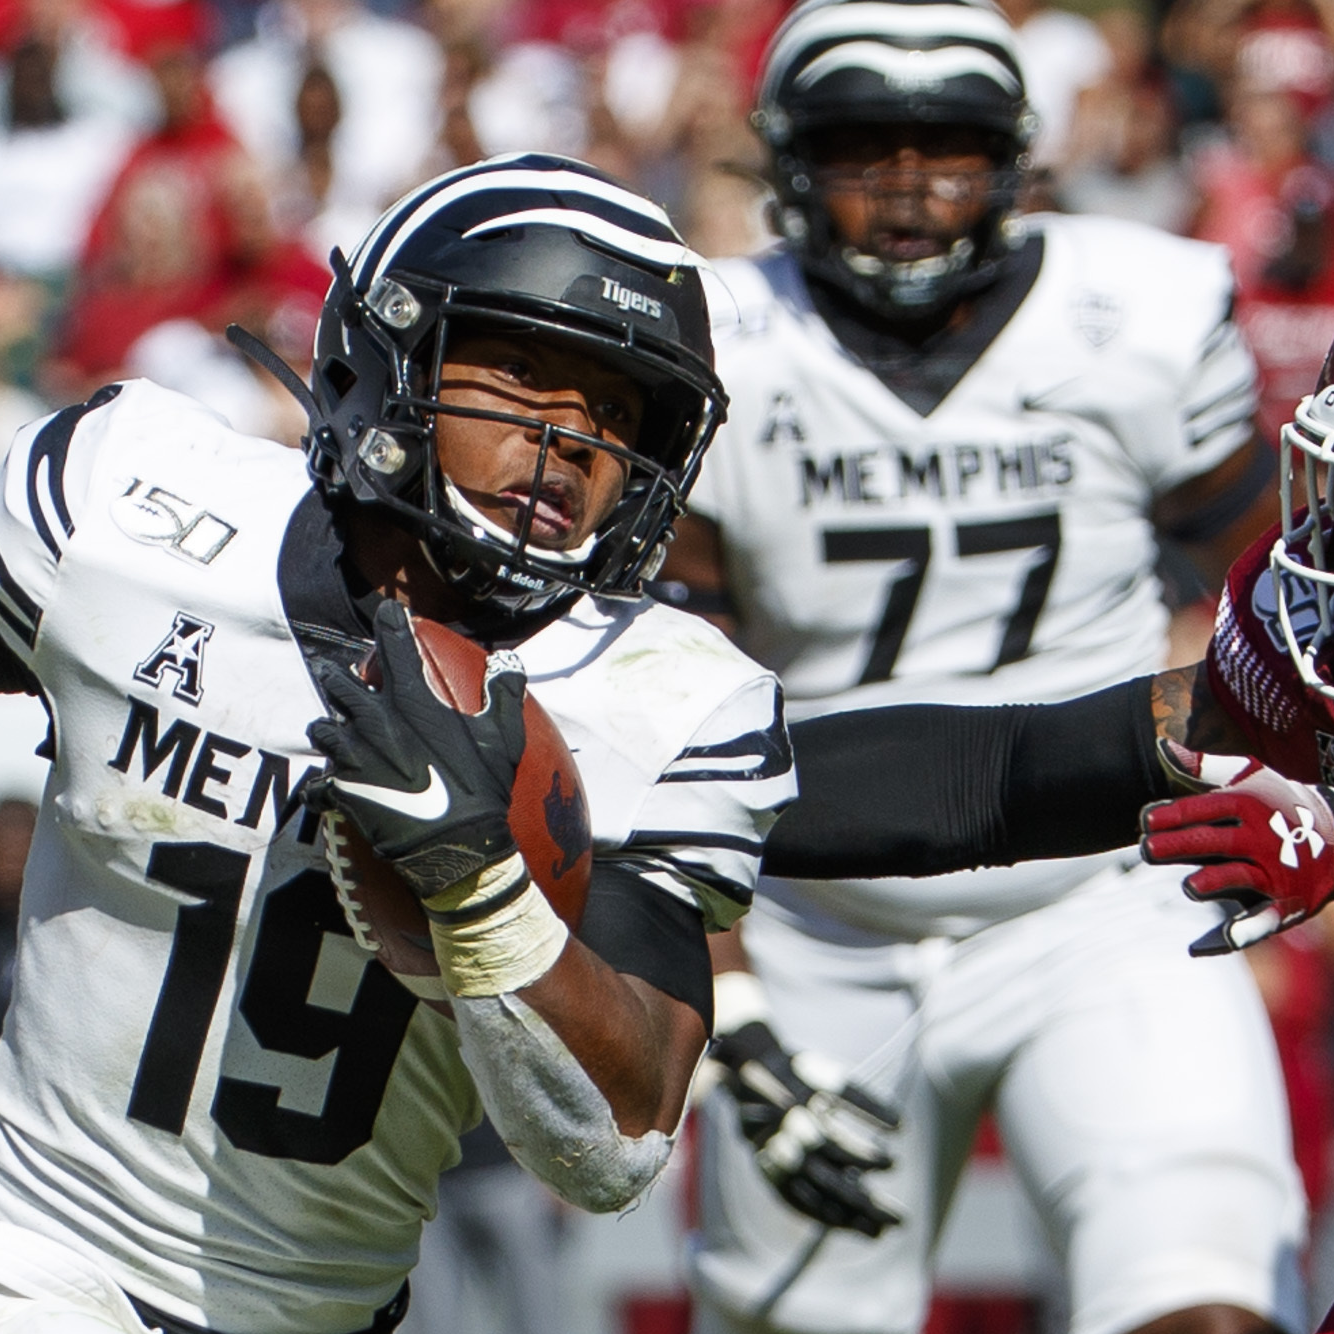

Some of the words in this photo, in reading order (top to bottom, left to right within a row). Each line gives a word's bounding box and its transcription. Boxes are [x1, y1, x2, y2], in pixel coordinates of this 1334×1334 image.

[601, 276, 661, 319] Tigers
[800, 431, 1075, 507] MEMPHIS
[111, 477, 238, 566] 150
[821, 504, 1062, 686] 77
[133, 611, 216, 709] A
[126, 841, 422, 1166] 19
